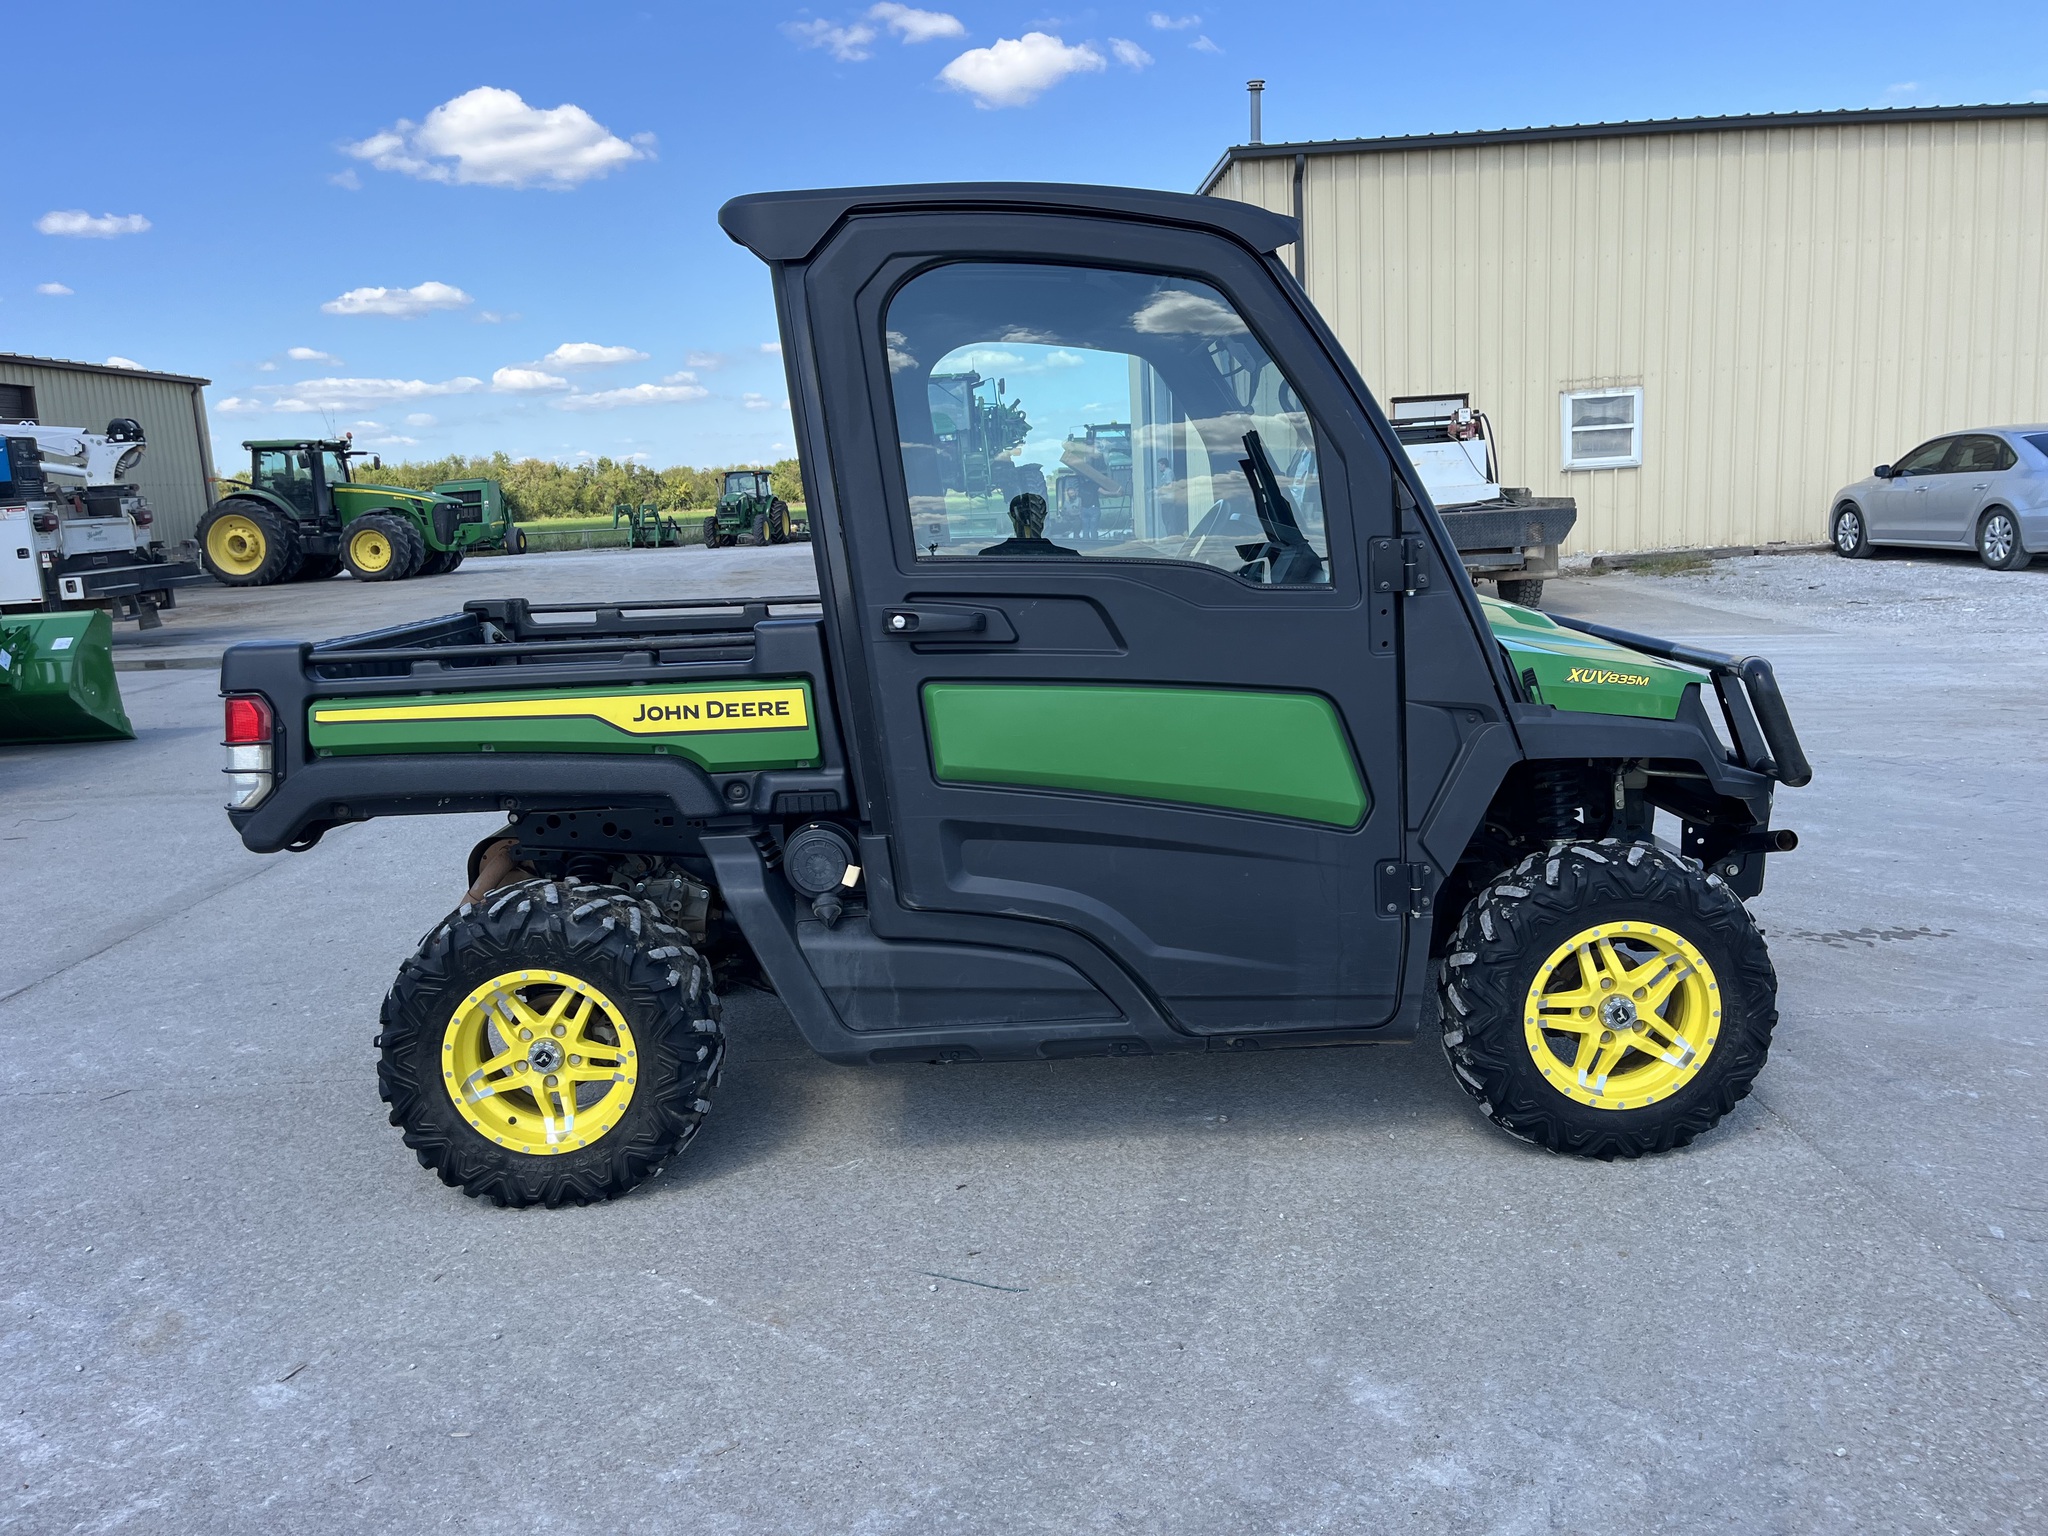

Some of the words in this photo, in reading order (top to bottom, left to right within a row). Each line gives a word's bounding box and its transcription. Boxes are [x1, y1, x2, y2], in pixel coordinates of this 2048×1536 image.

[1566, 668, 1650, 686] XUV835M
[633, 704, 700, 722] JOHN
[706, 700, 790, 719] DEERE
